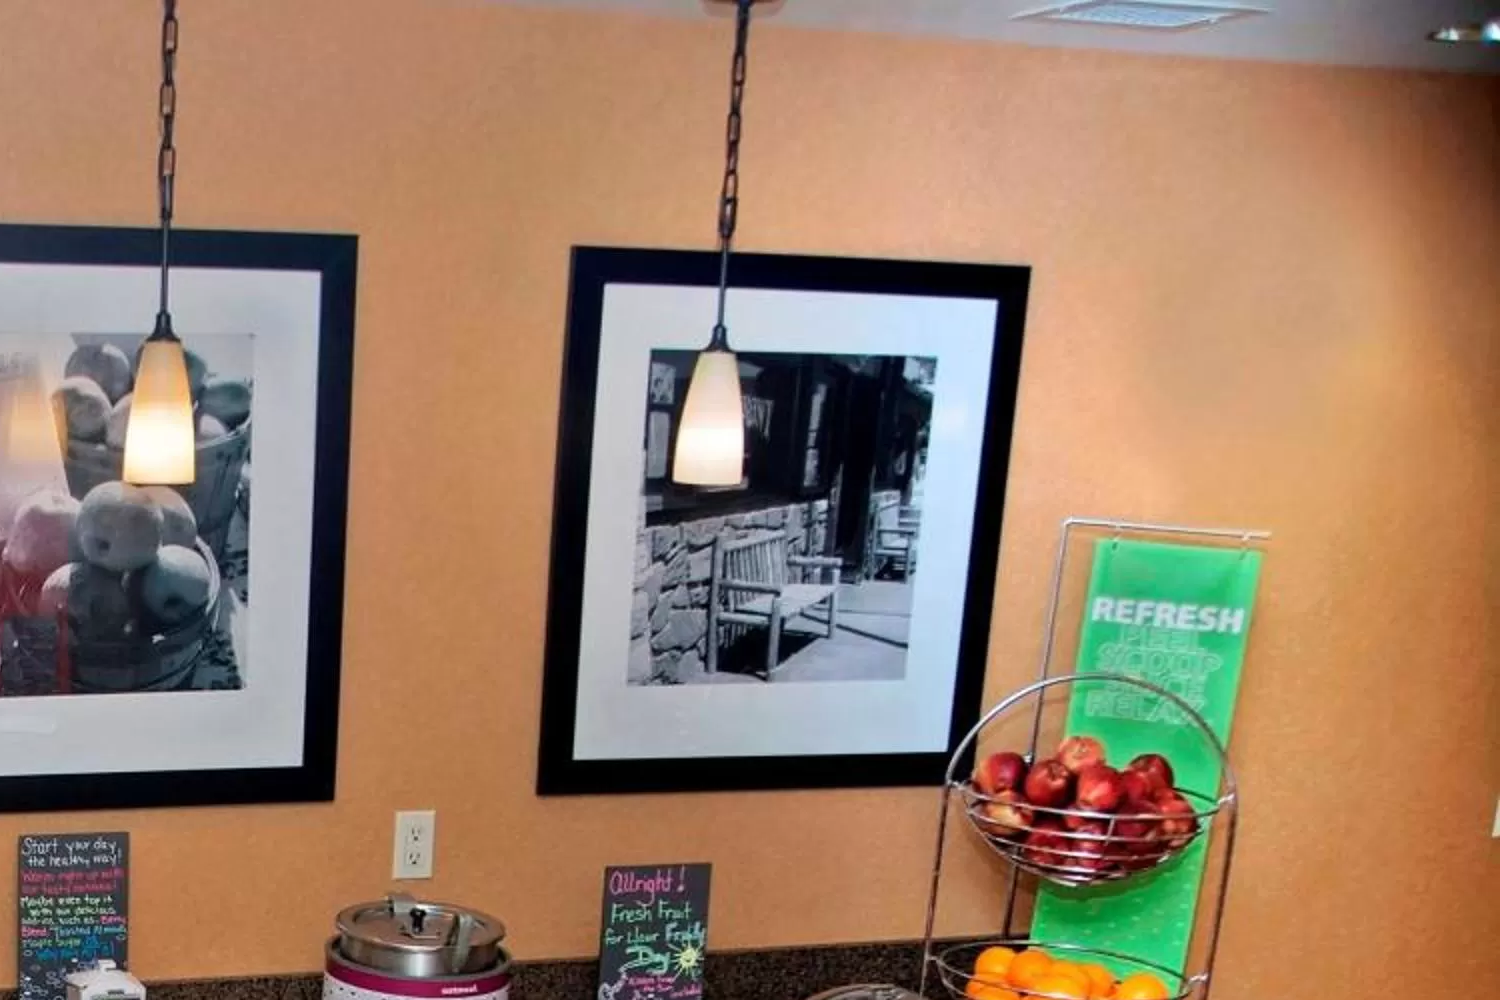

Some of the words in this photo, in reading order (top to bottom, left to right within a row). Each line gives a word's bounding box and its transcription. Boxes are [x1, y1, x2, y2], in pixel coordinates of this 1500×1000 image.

[1091, 596, 1245, 634] REFRESH
[21, 837, 58, 857] Start
[65, 841, 90, 857] your
[93, 836, 117, 855] day
[27, 855, 46, 868] the
[611, 902, 653, 926] Fresh
[658, 898, 692, 921] Fruit
[623, 944, 671, 976] Day
